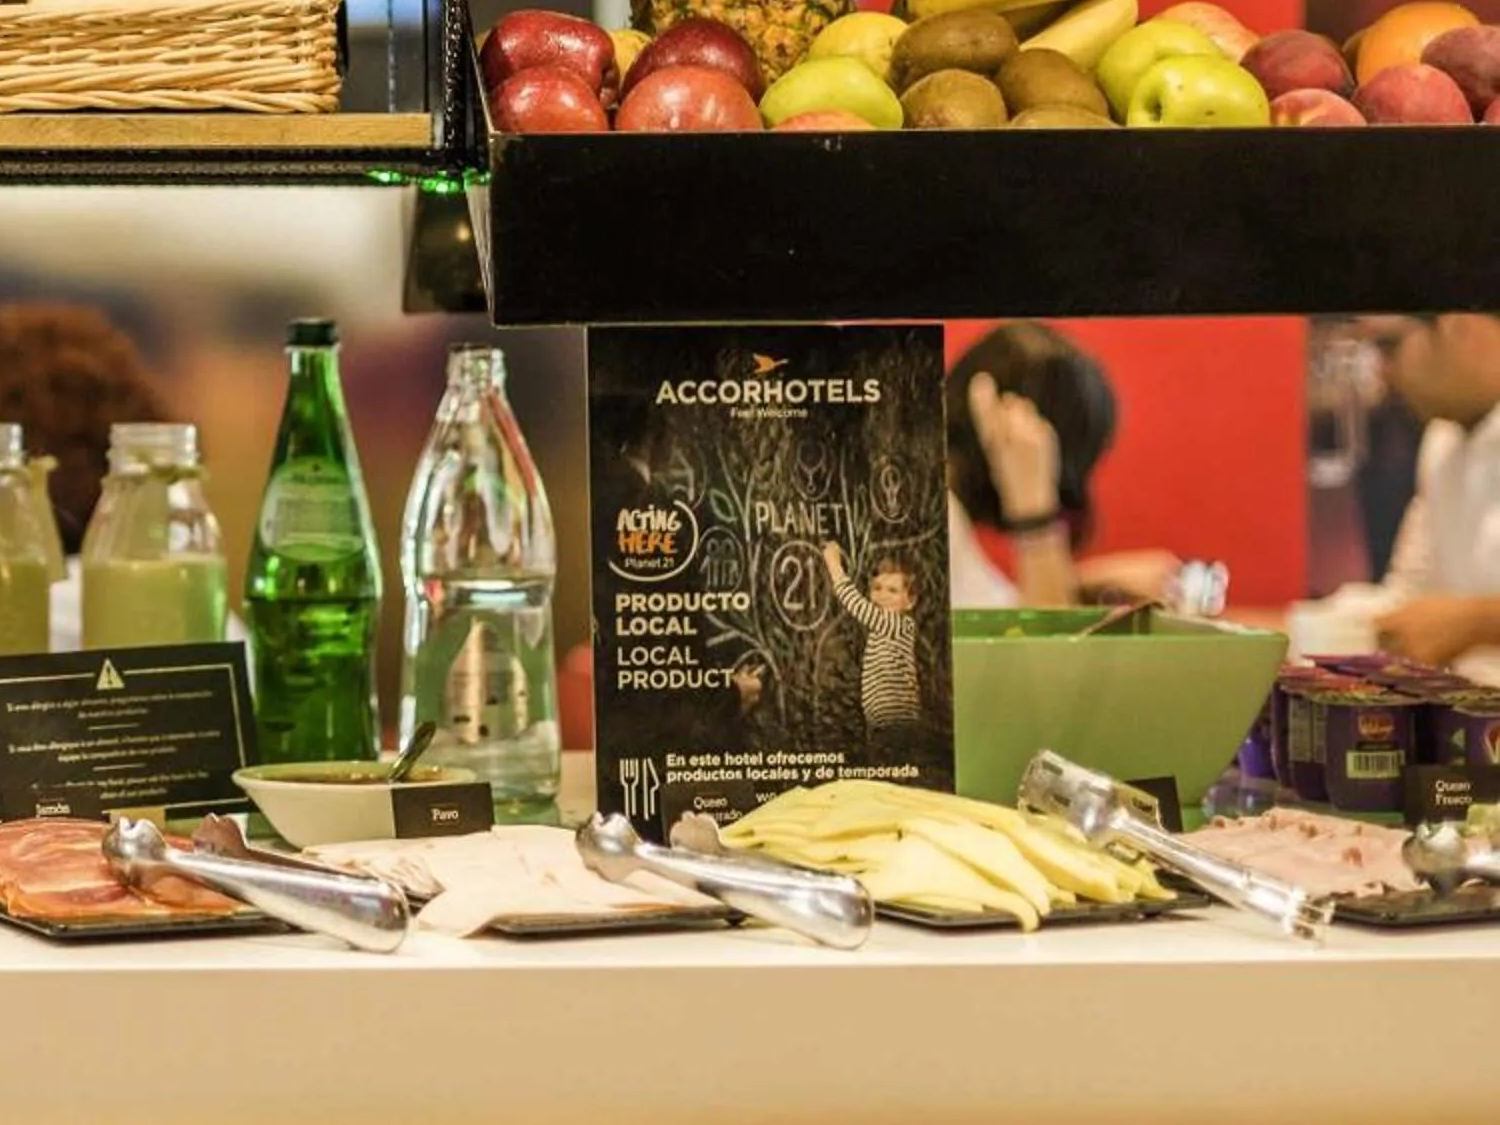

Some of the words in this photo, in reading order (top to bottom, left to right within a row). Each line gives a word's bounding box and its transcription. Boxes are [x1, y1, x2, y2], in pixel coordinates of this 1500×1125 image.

[656, 379, 881, 404] ACCORHOTELS
[754, 501, 843, 535] PLANET
[618, 531, 678, 554] HERE
[780, 555, 817, 610] 21
[615, 593, 750, 612] PRODUCTO
[615, 617, 697, 636] LOCAL
[617, 647, 699, 665] LOCAL
[617, 668, 735, 690] PRODUCT
[666, 754, 685, 767] En
[689, 754, 720, 766] este
[725, 751, 763, 766] hotel
[766, 751, 844, 765] ofrecemos
[666, 768, 742, 783] productos
[746, 766, 798, 780] locales
[802, 767, 810, 781] y
[815, 765, 834, 779] de
[837, 763, 918, 779] temporada
[1435, 780, 1470, 794] Queso
[693, 796, 728, 810] Queso
[1435, 793, 1472, 806] Fresco
[431, 808, 459, 821] Pavo
